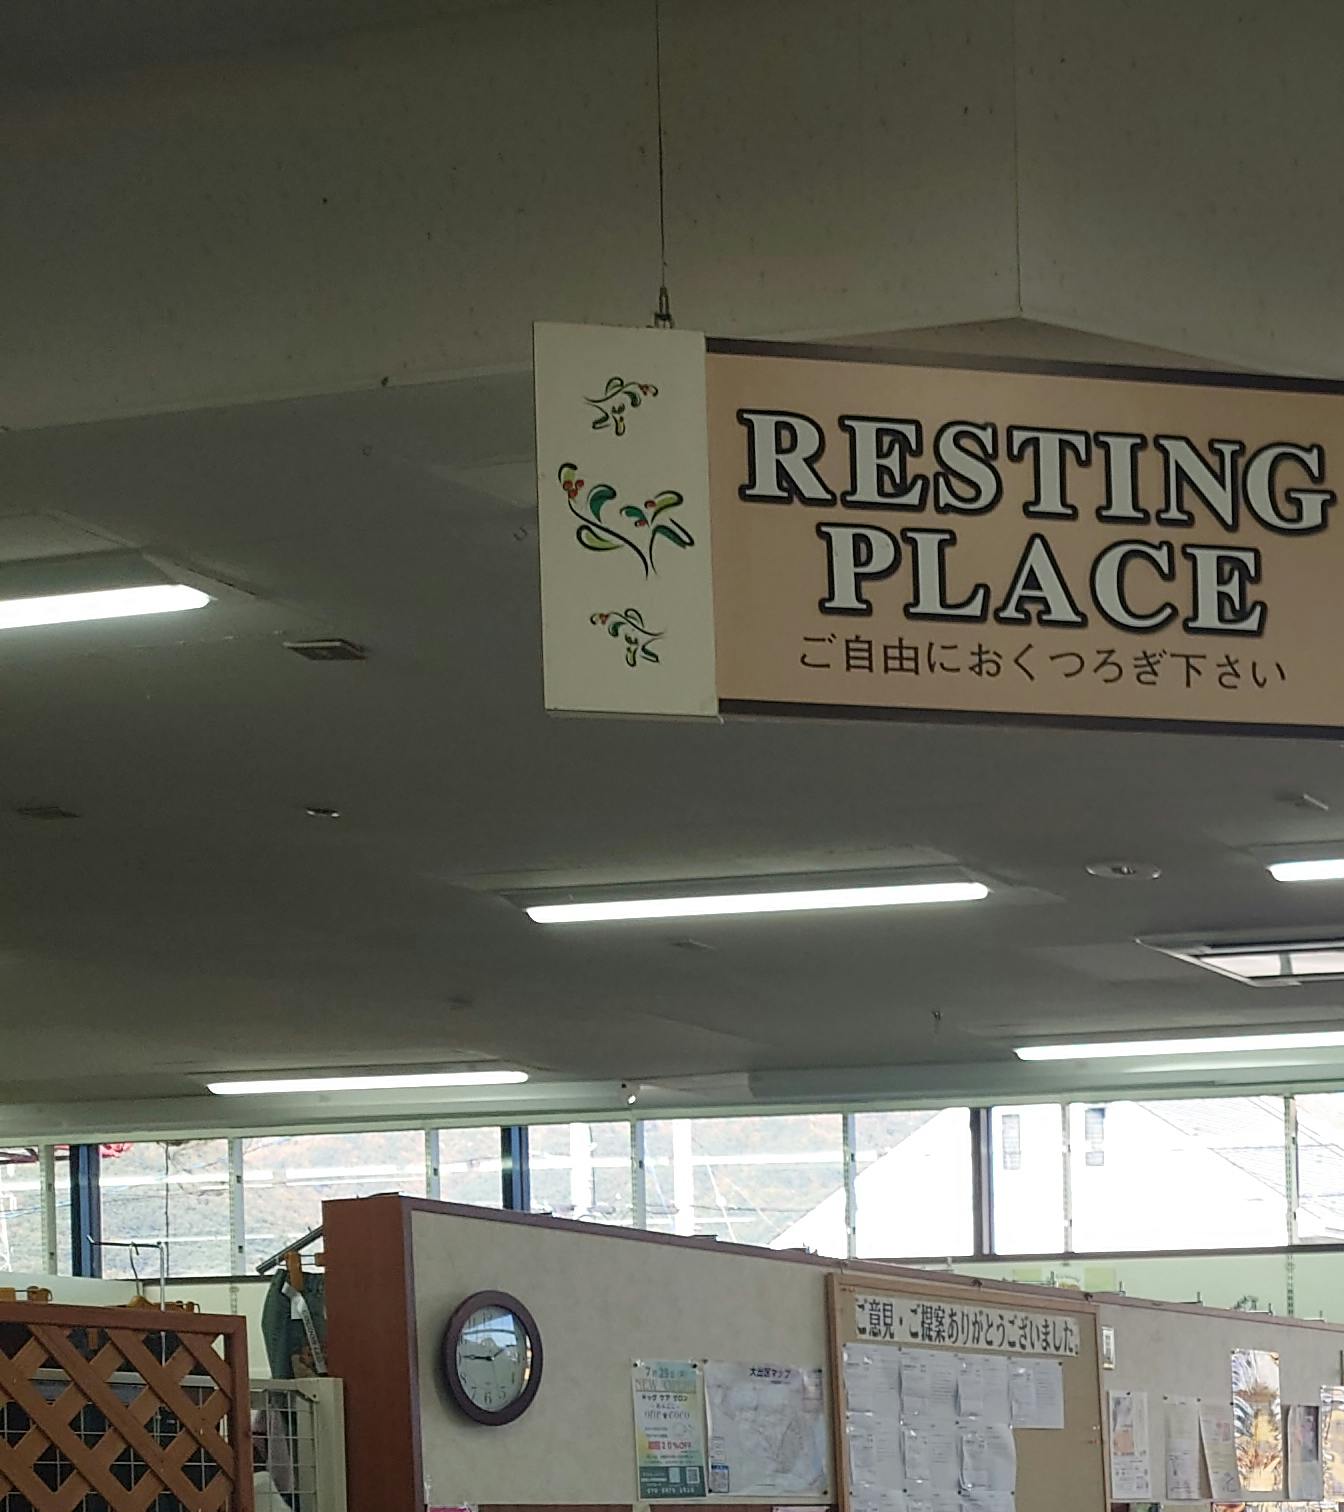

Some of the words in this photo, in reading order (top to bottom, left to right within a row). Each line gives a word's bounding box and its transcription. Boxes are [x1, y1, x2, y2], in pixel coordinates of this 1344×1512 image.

[737, 408, 1336, 536] RESTING
[817, 521, 1267, 636] PLACE
[799, 633, 1286, 690] ご自由におくつろぎ下さい
[857, 1297, 1079, 1355] ご意見・ご提案ありがとうございました。
